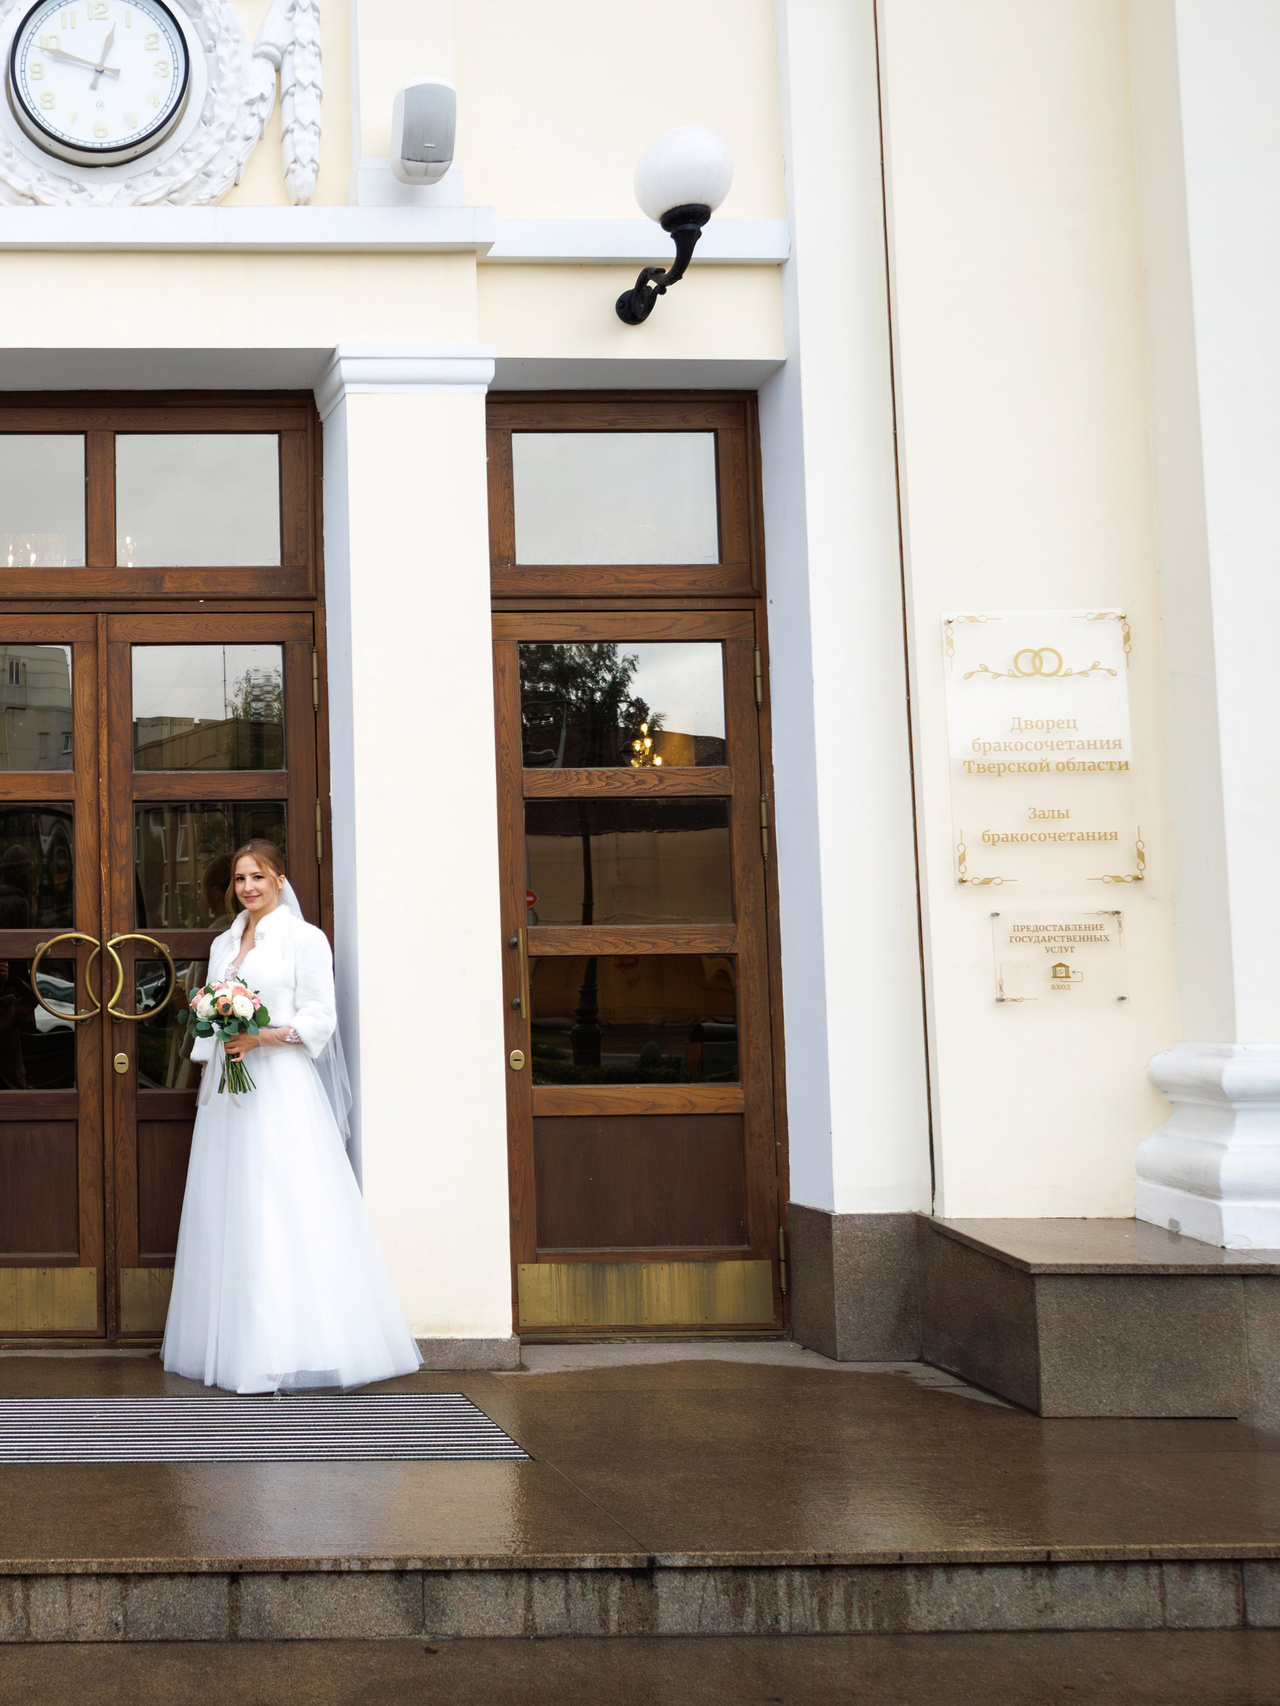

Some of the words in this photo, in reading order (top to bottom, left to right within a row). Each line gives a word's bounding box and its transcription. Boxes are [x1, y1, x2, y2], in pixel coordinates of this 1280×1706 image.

[61, 10, 76, 29] 11
[87, 1, 109, 21] 12
[125, 9, 131, 28] 1
[39, 34, 62, 52] 10
[145, 32, 160, 51] 2
[30, 61, 45, 80] 9
[154, 59, 169, 78] 3
[40, 91, 55, 110] 8
[1010, 716, 1078, 733] Дворец
[971, 737, 1123, 755] бракосочетания
[963, 758, 1051, 777] Тверской
[1055, 757, 1130, 773] области
[1028, 807, 1070, 820] Залы
[981, 829, 1119, 846] бракосочетания
[1012, 923, 1105, 932] ПРЕДОСТАВЛЕНИЕ
[1009, 934, 1110, 943] ГОСУДАРСТВЕННЫХ
[1044, 946, 1076, 954] УСЛУГ
